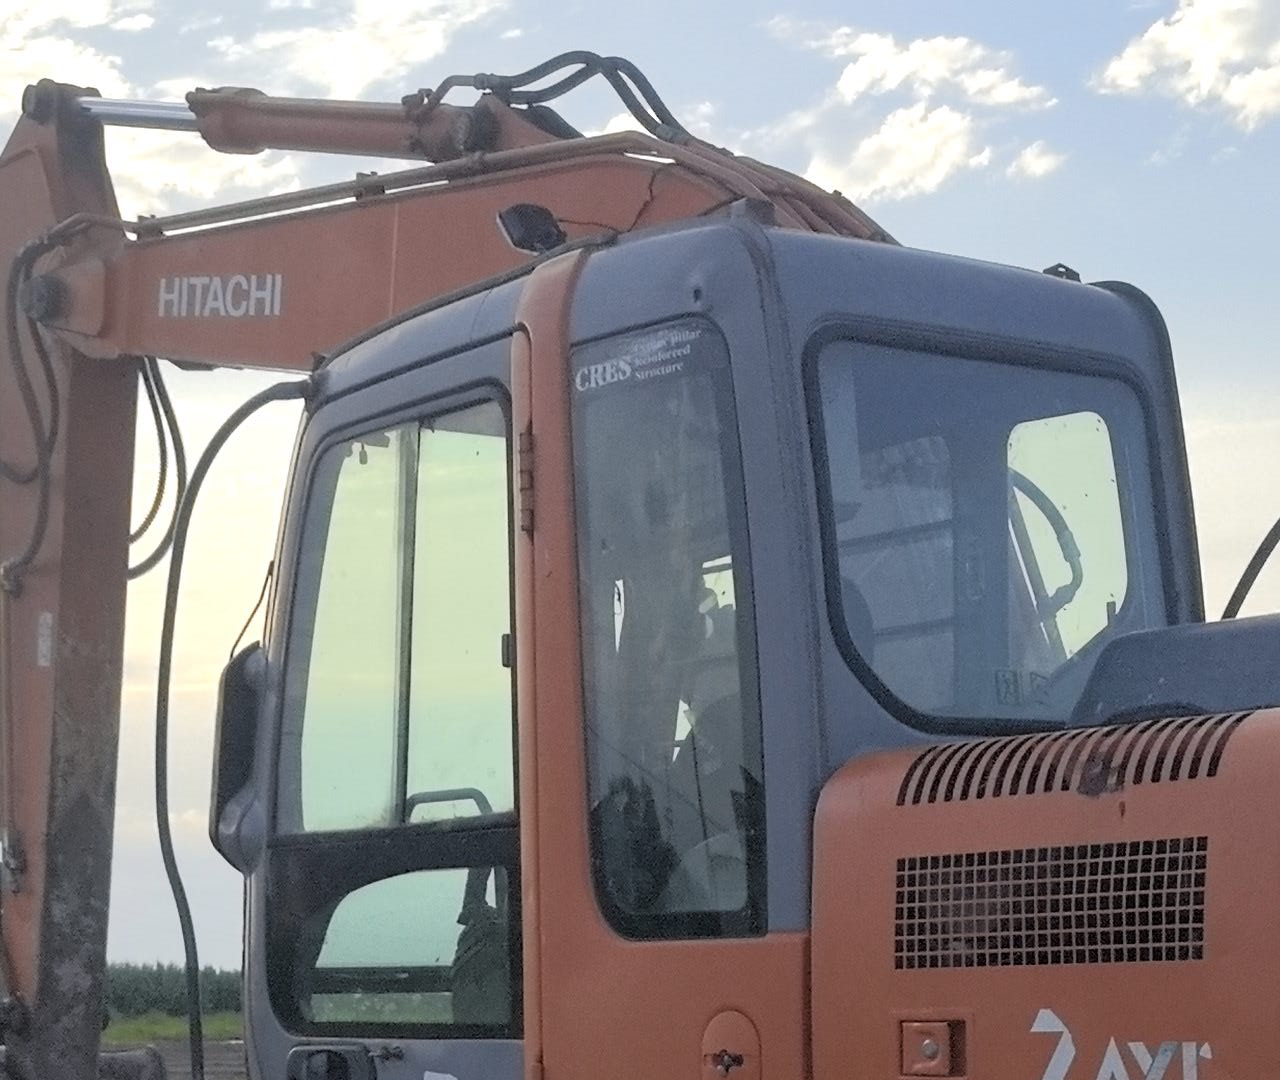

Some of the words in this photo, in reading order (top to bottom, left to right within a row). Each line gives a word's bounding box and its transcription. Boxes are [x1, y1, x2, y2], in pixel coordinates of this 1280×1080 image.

[158, 274, 282, 318] HITACHI
[575, 355, 633, 392] CRES
[634, 361, 684, 380] Structure
